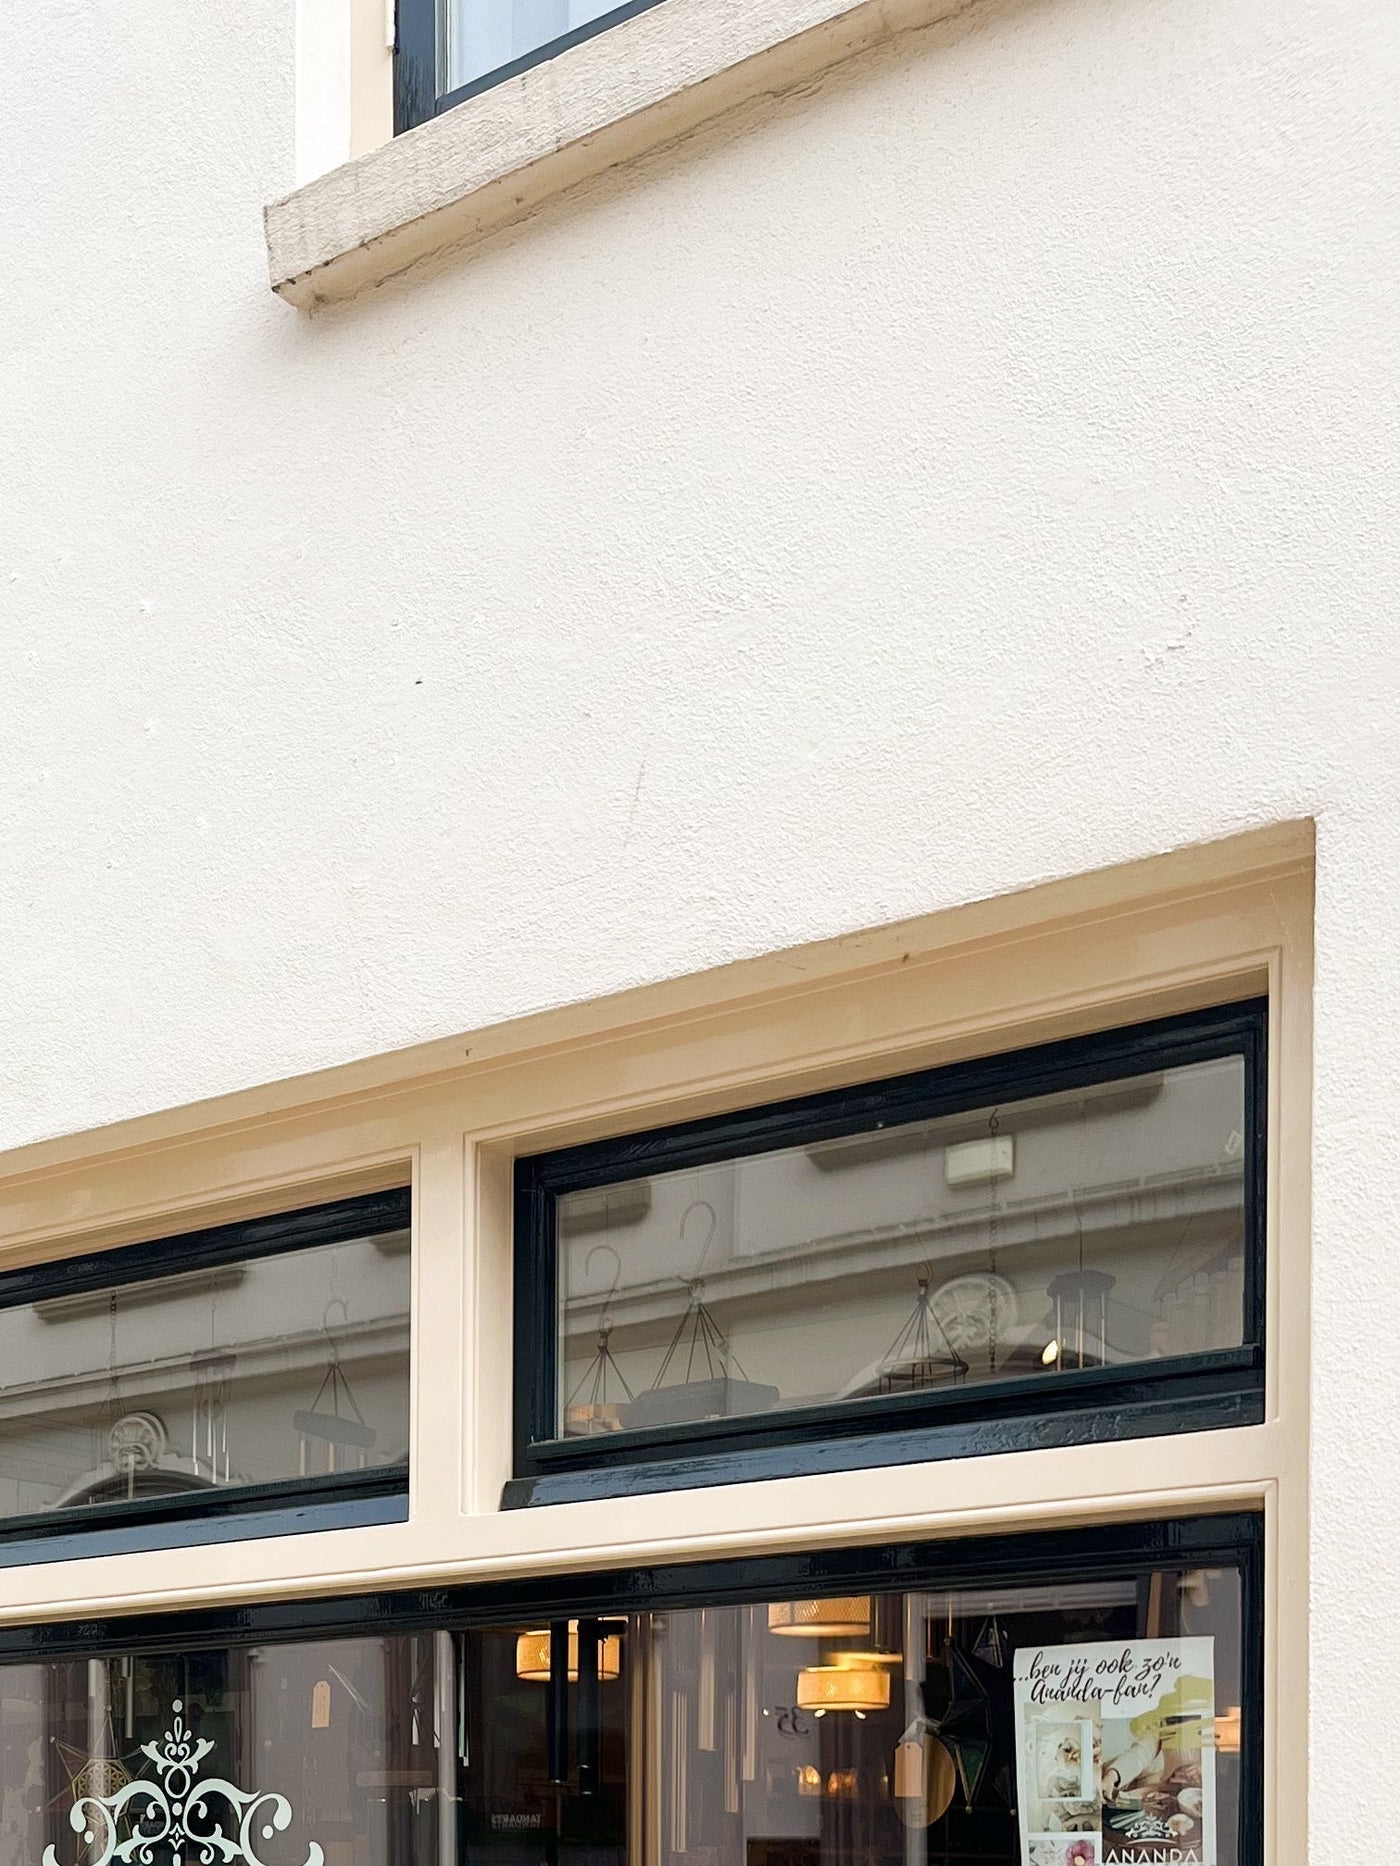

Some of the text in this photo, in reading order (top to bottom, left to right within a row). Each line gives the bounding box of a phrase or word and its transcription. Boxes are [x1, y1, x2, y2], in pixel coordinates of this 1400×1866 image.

[1060, 1658, 1090, 1689] jij
[1096, 1648, 1134, 1674] ook
[1135, 1652, 1182, 1681] zo'n
[1031, 1673, 1162, 1705] Ananda-fan?
[1105, 1848, 1199, 1864] ANANDA
